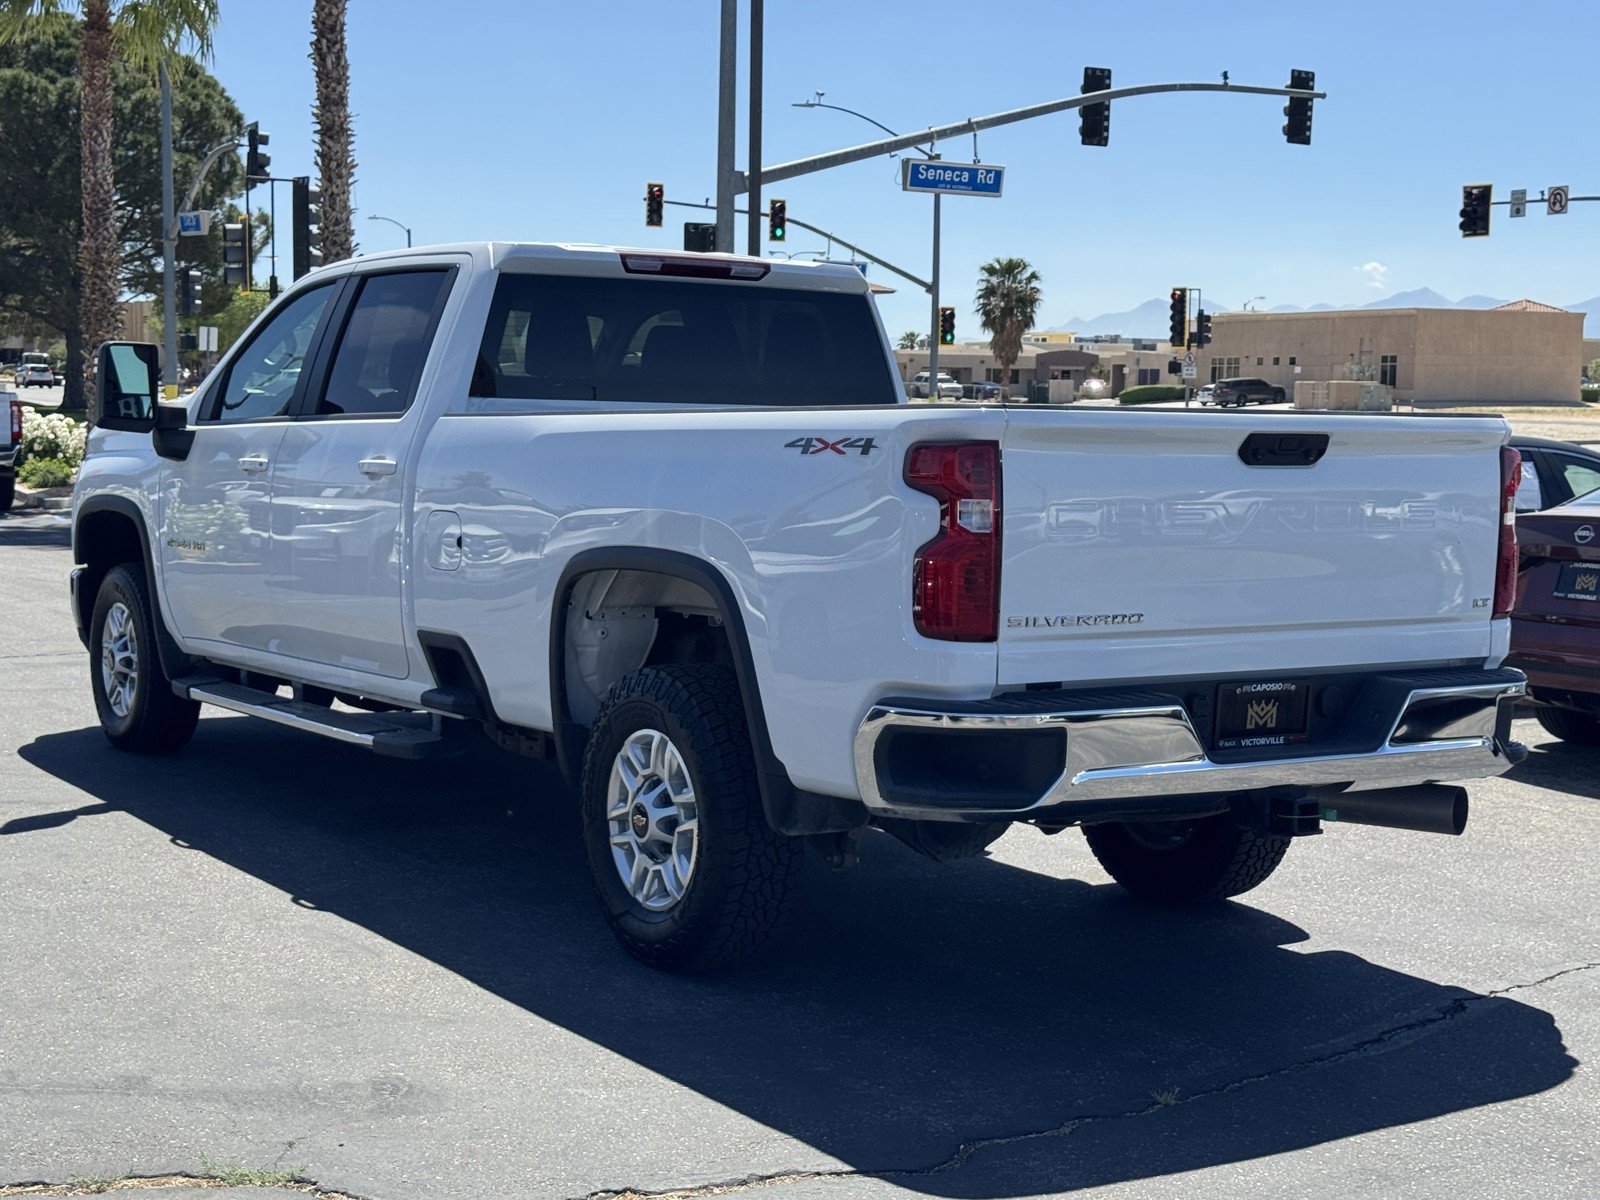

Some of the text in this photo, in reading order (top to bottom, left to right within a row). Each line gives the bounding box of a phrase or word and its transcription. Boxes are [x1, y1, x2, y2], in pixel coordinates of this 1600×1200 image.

[918, 165, 995, 184] Seneca Rd
[1007, 613, 1144, 628] SILVERADO
[1251, 683, 1283, 692] CAPOSIO
[1241, 736, 1285, 747] VICTORVILLE
